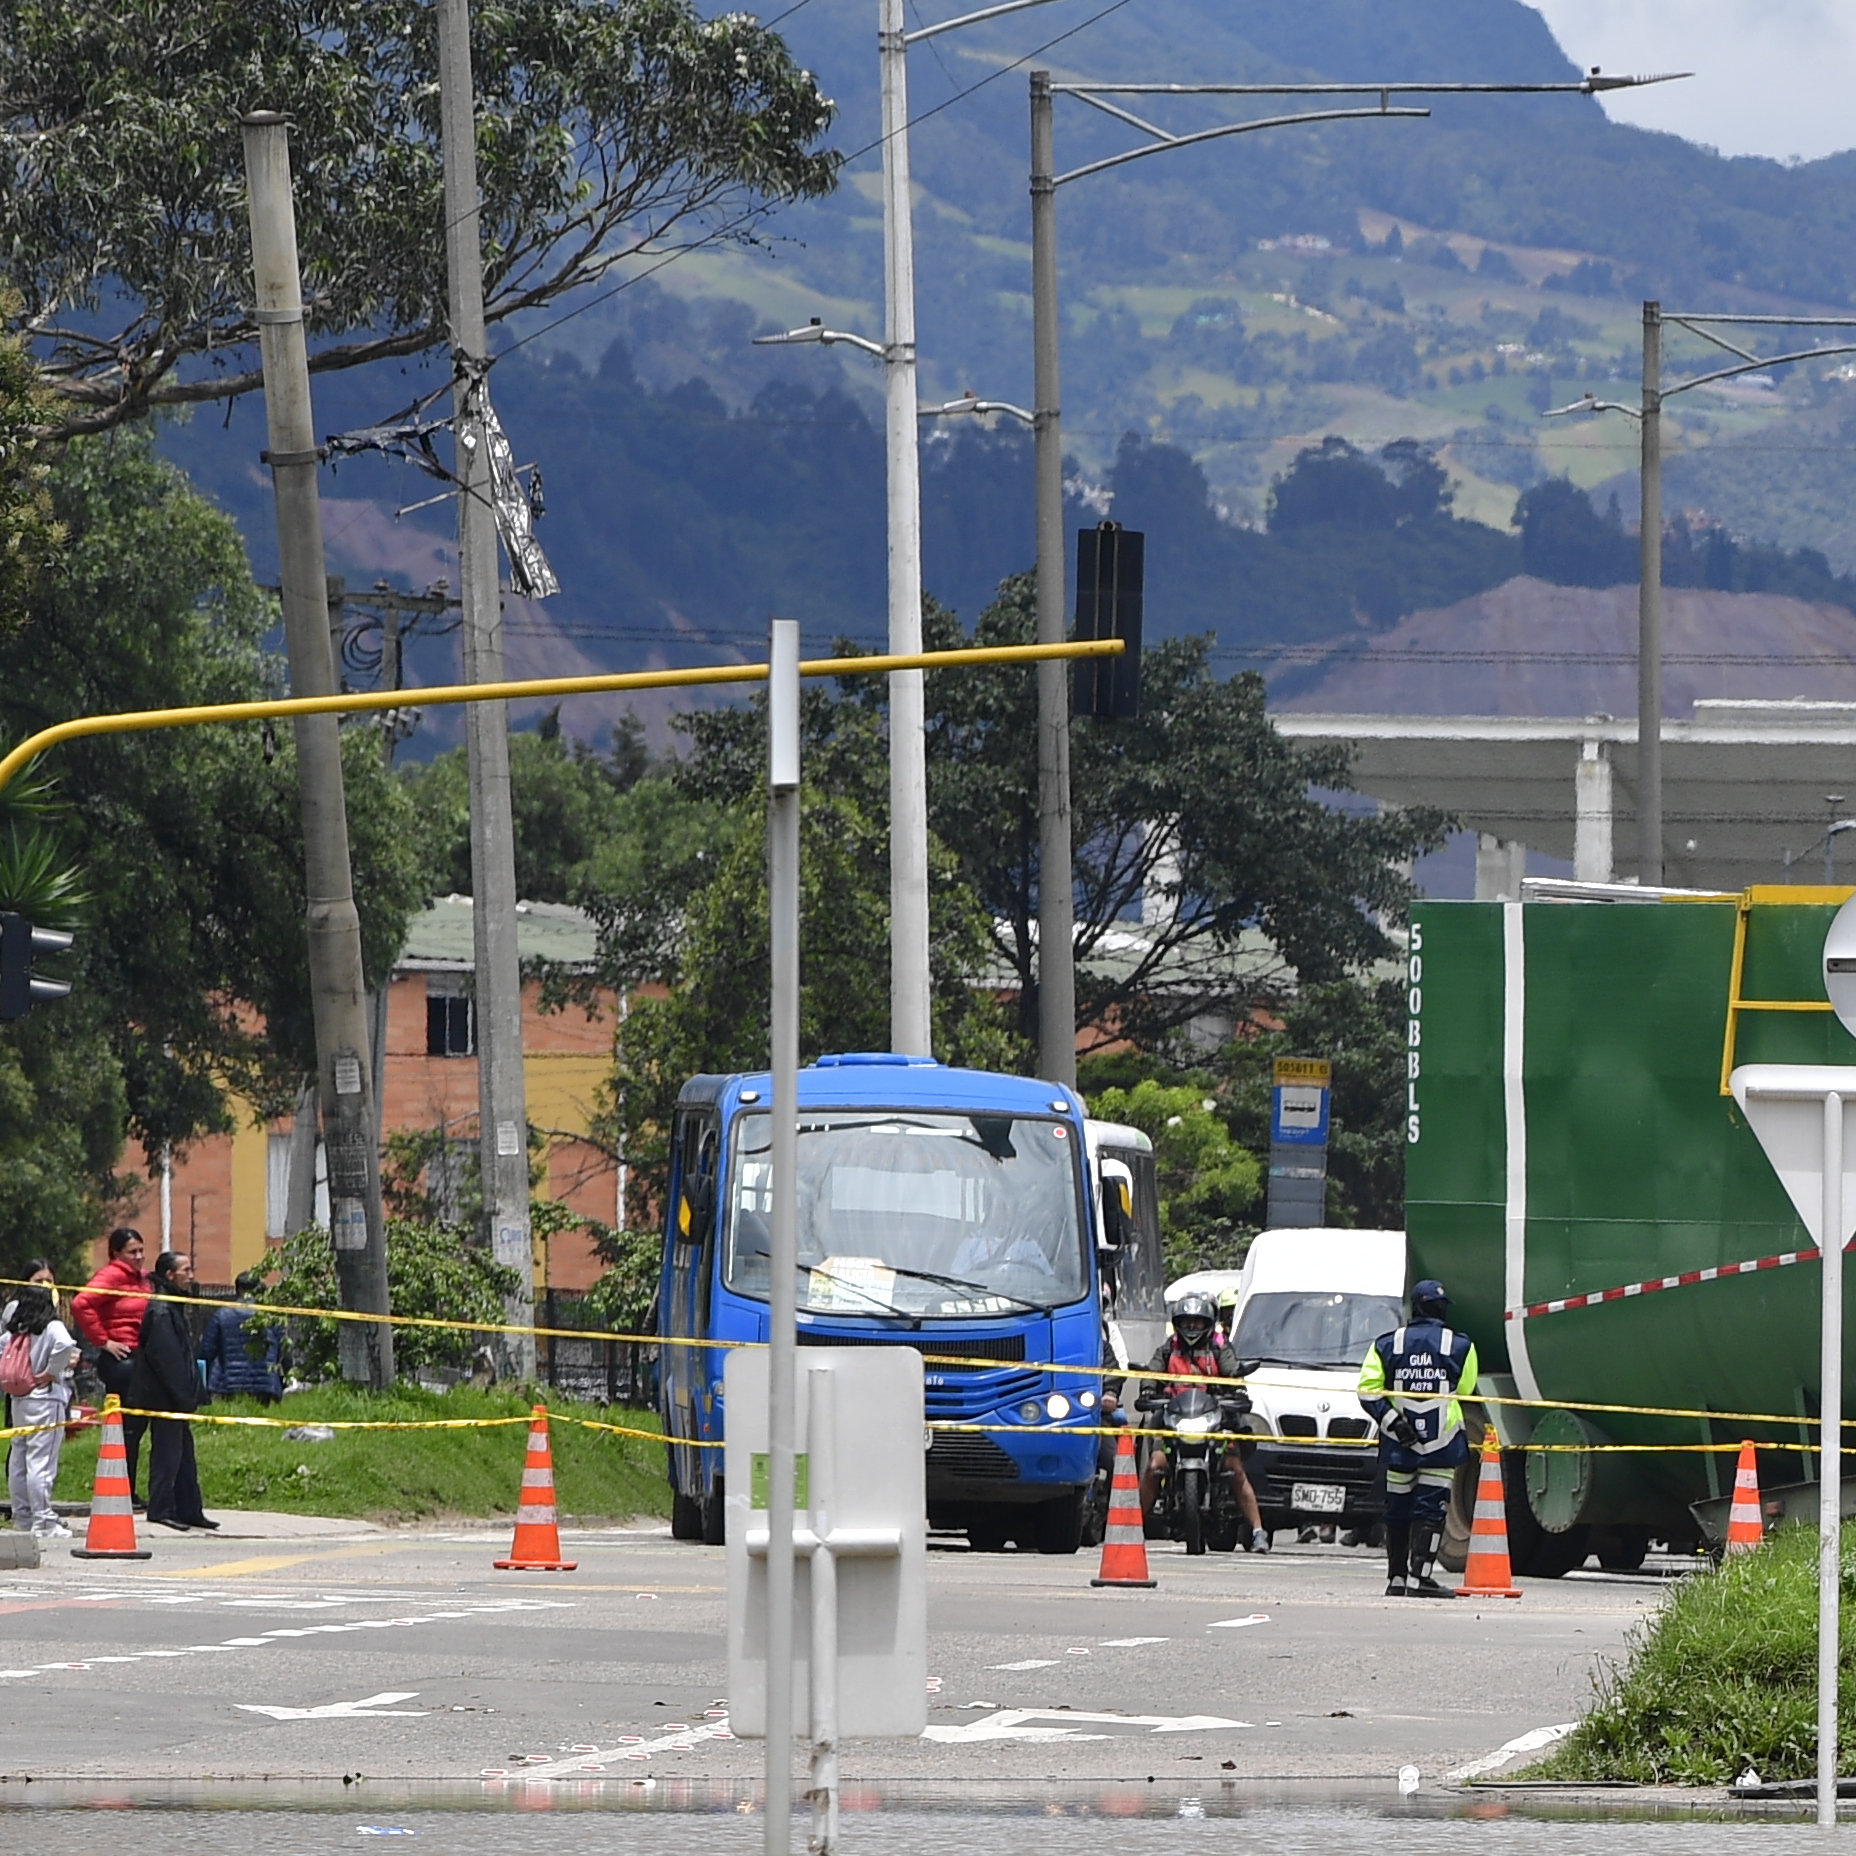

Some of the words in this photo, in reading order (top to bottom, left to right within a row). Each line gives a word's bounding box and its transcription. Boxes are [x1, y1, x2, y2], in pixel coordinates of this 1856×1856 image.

[1407, 923, 1422, 1144] 500BBLS
[1409, 1352, 1433, 1367] GUÍA
[1395, 1367, 1447, 1380] MOVILIDAD
